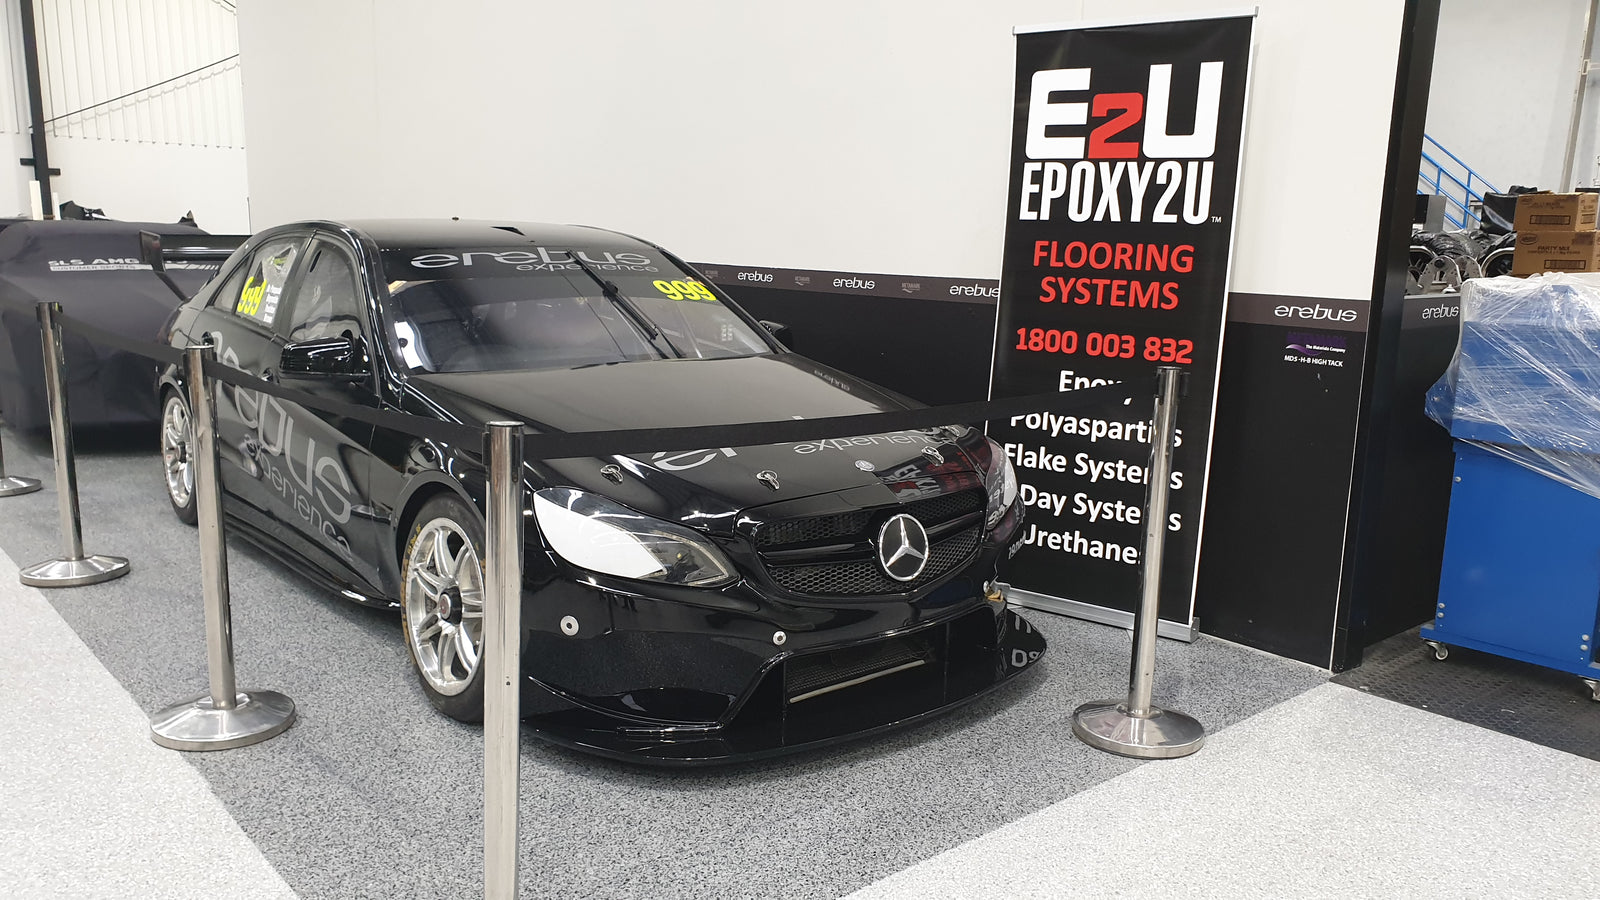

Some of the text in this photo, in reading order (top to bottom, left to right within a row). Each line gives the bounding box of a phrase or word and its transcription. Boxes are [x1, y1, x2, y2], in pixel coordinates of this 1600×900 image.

[1025, 61, 1224, 159] E2U
[1019, 160, 1215, 225] EPOXY2U
[411, 247, 650, 268] erebus
[1033, 240, 1195, 273] FLOORING
[516, 263, 659, 273] experience
[737, 271, 774, 283] erebus
[653, 280, 718, 301] 999
[833, 277, 876, 290] erebus
[949, 283, 1000, 298] erebus
[1039, 276, 1179, 310] SYSTEMS
[1274, 303, 1358, 322] erebus
[1422, 303, 1459, 319] erebus
[1015, 327, 1194, 364] 1800 003 832
[1312, 357, 1327, 366] HIGH
[1328, 359, 1344, 368] TACK
[1010, 411, 1183, 448] olyaspartis
[794, 431, 952, 455] experienc
[1004, 443, 1184, 490] Flake Systes
[1020, 484, 1182, 532] Day Systes
